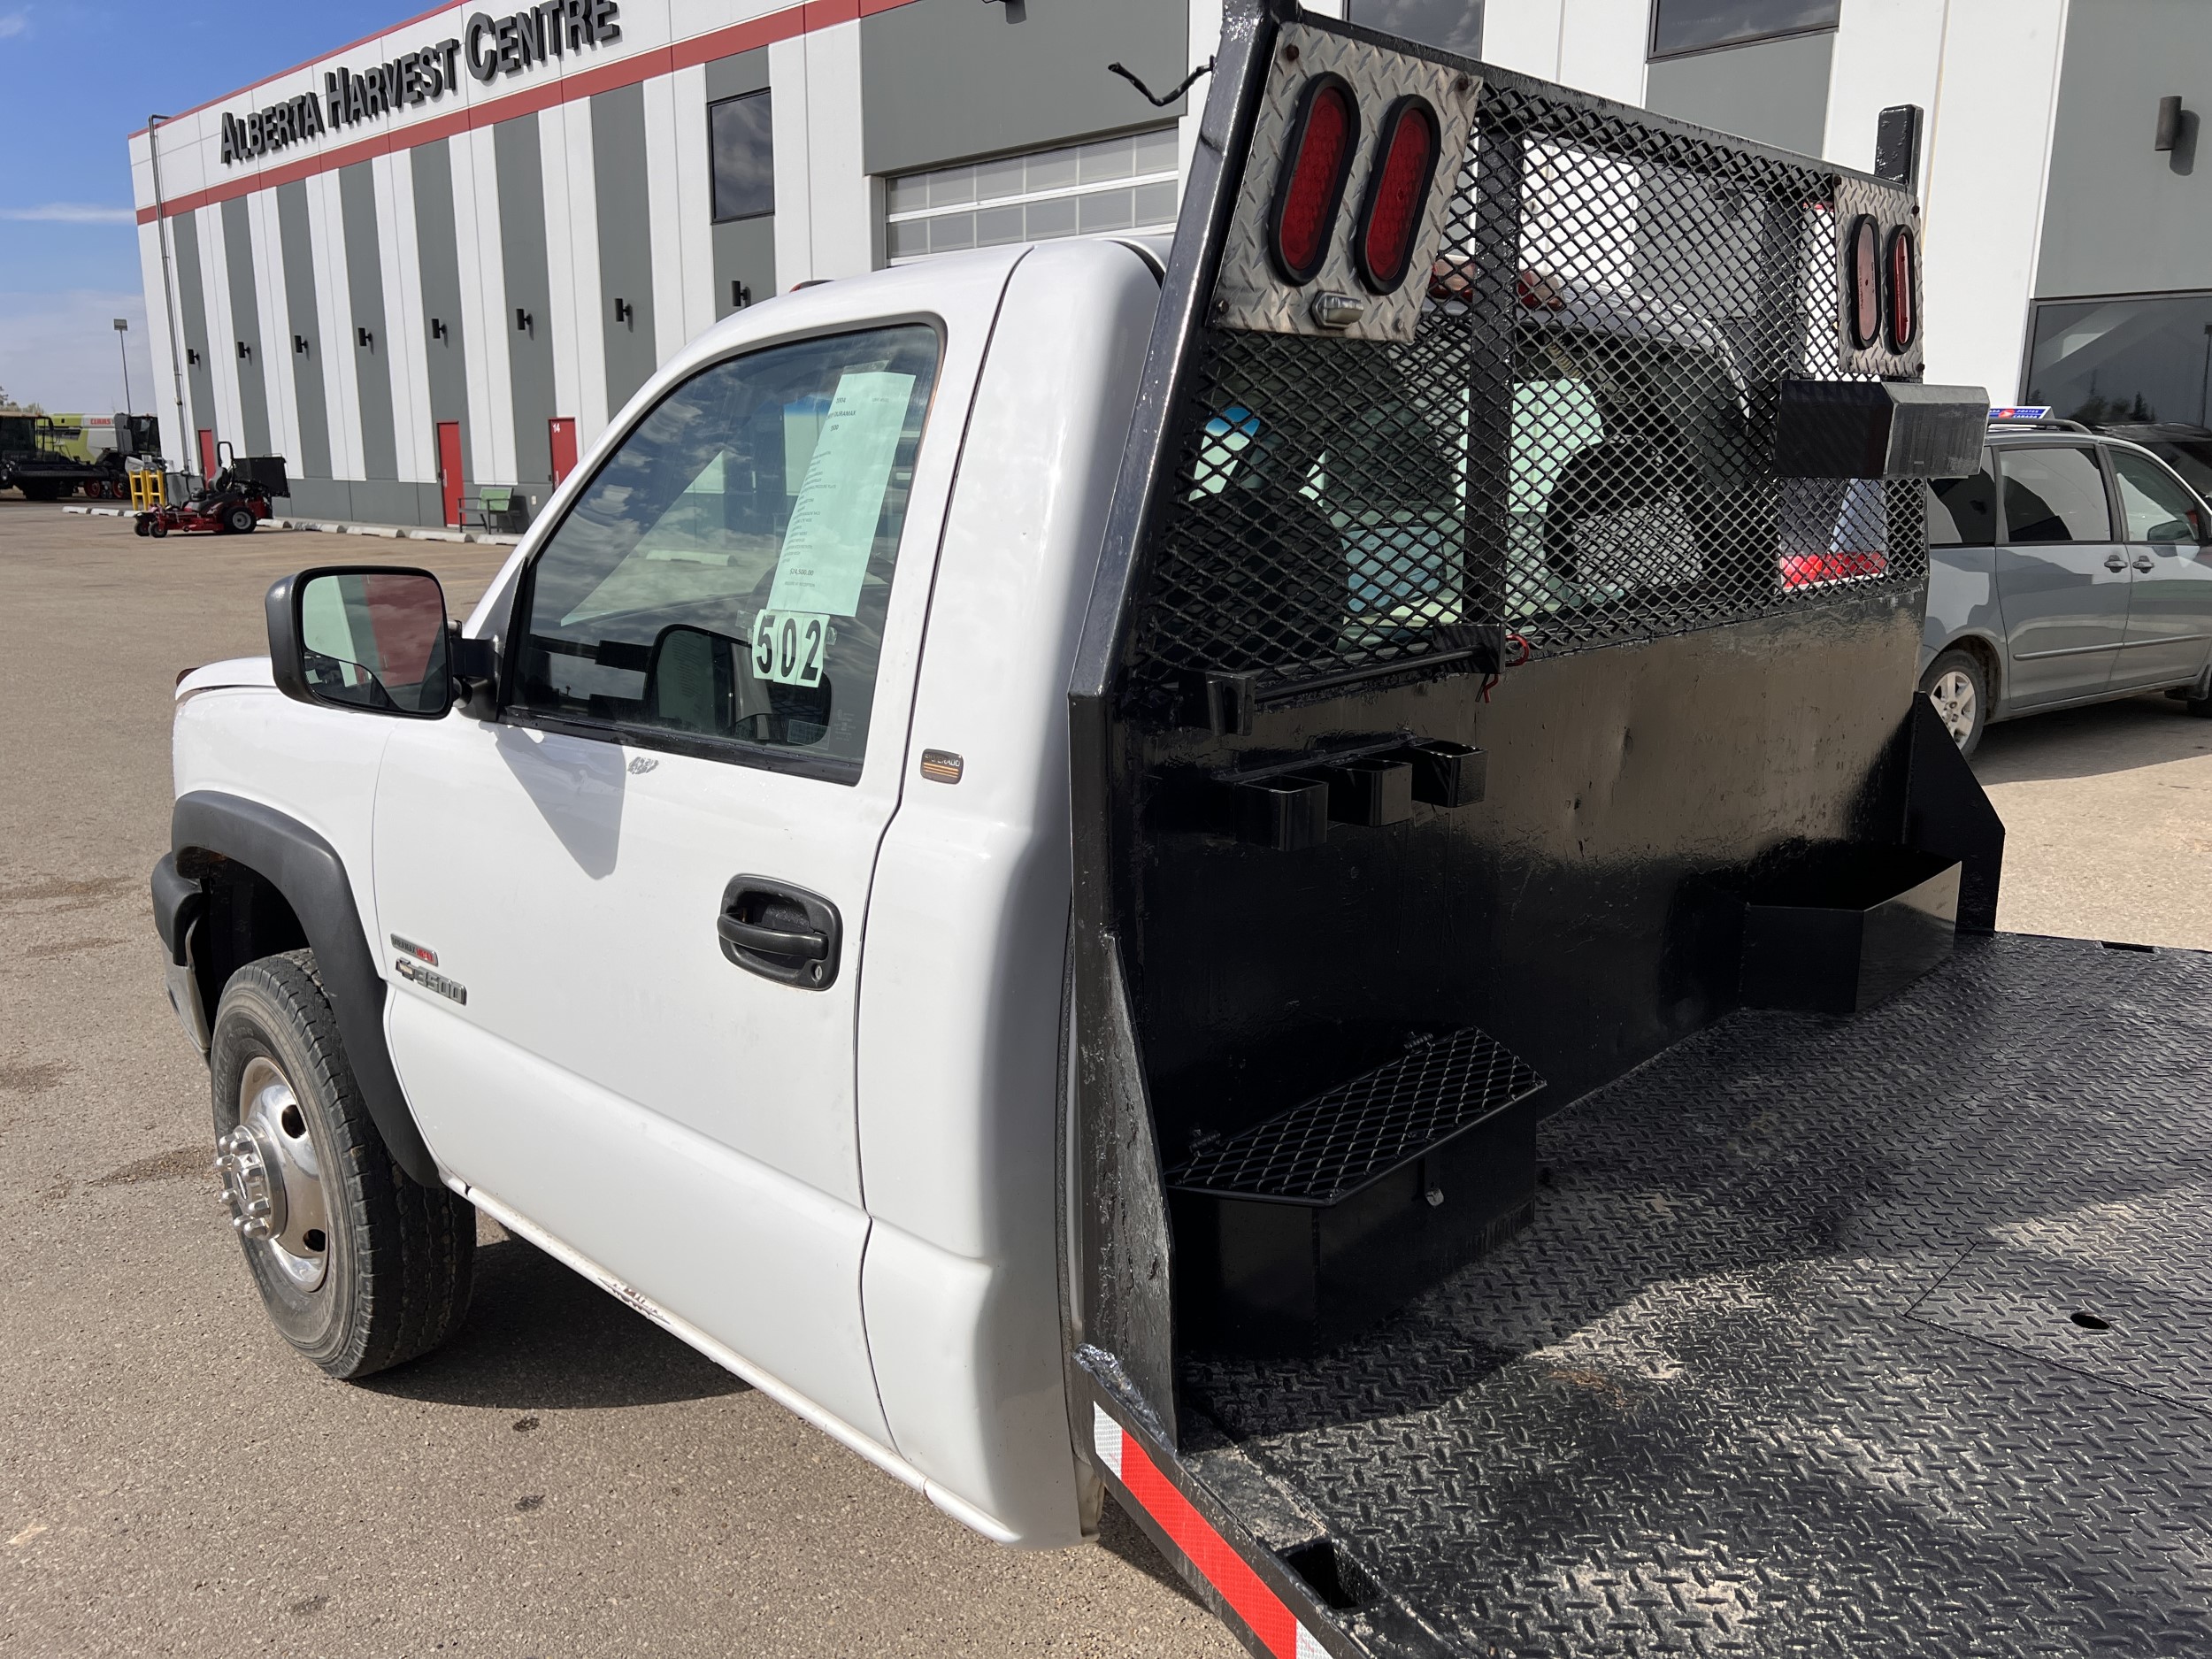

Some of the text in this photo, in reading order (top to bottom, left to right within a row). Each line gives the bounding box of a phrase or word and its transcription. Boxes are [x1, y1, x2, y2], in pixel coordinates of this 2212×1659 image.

[221, 0, 620, 164] ALBERTA HARVEST CENTRE
[553, 423, 560, 433] 14
[757, 615, 821, 681] 502
[414, 966, 467, 1006] 3500
